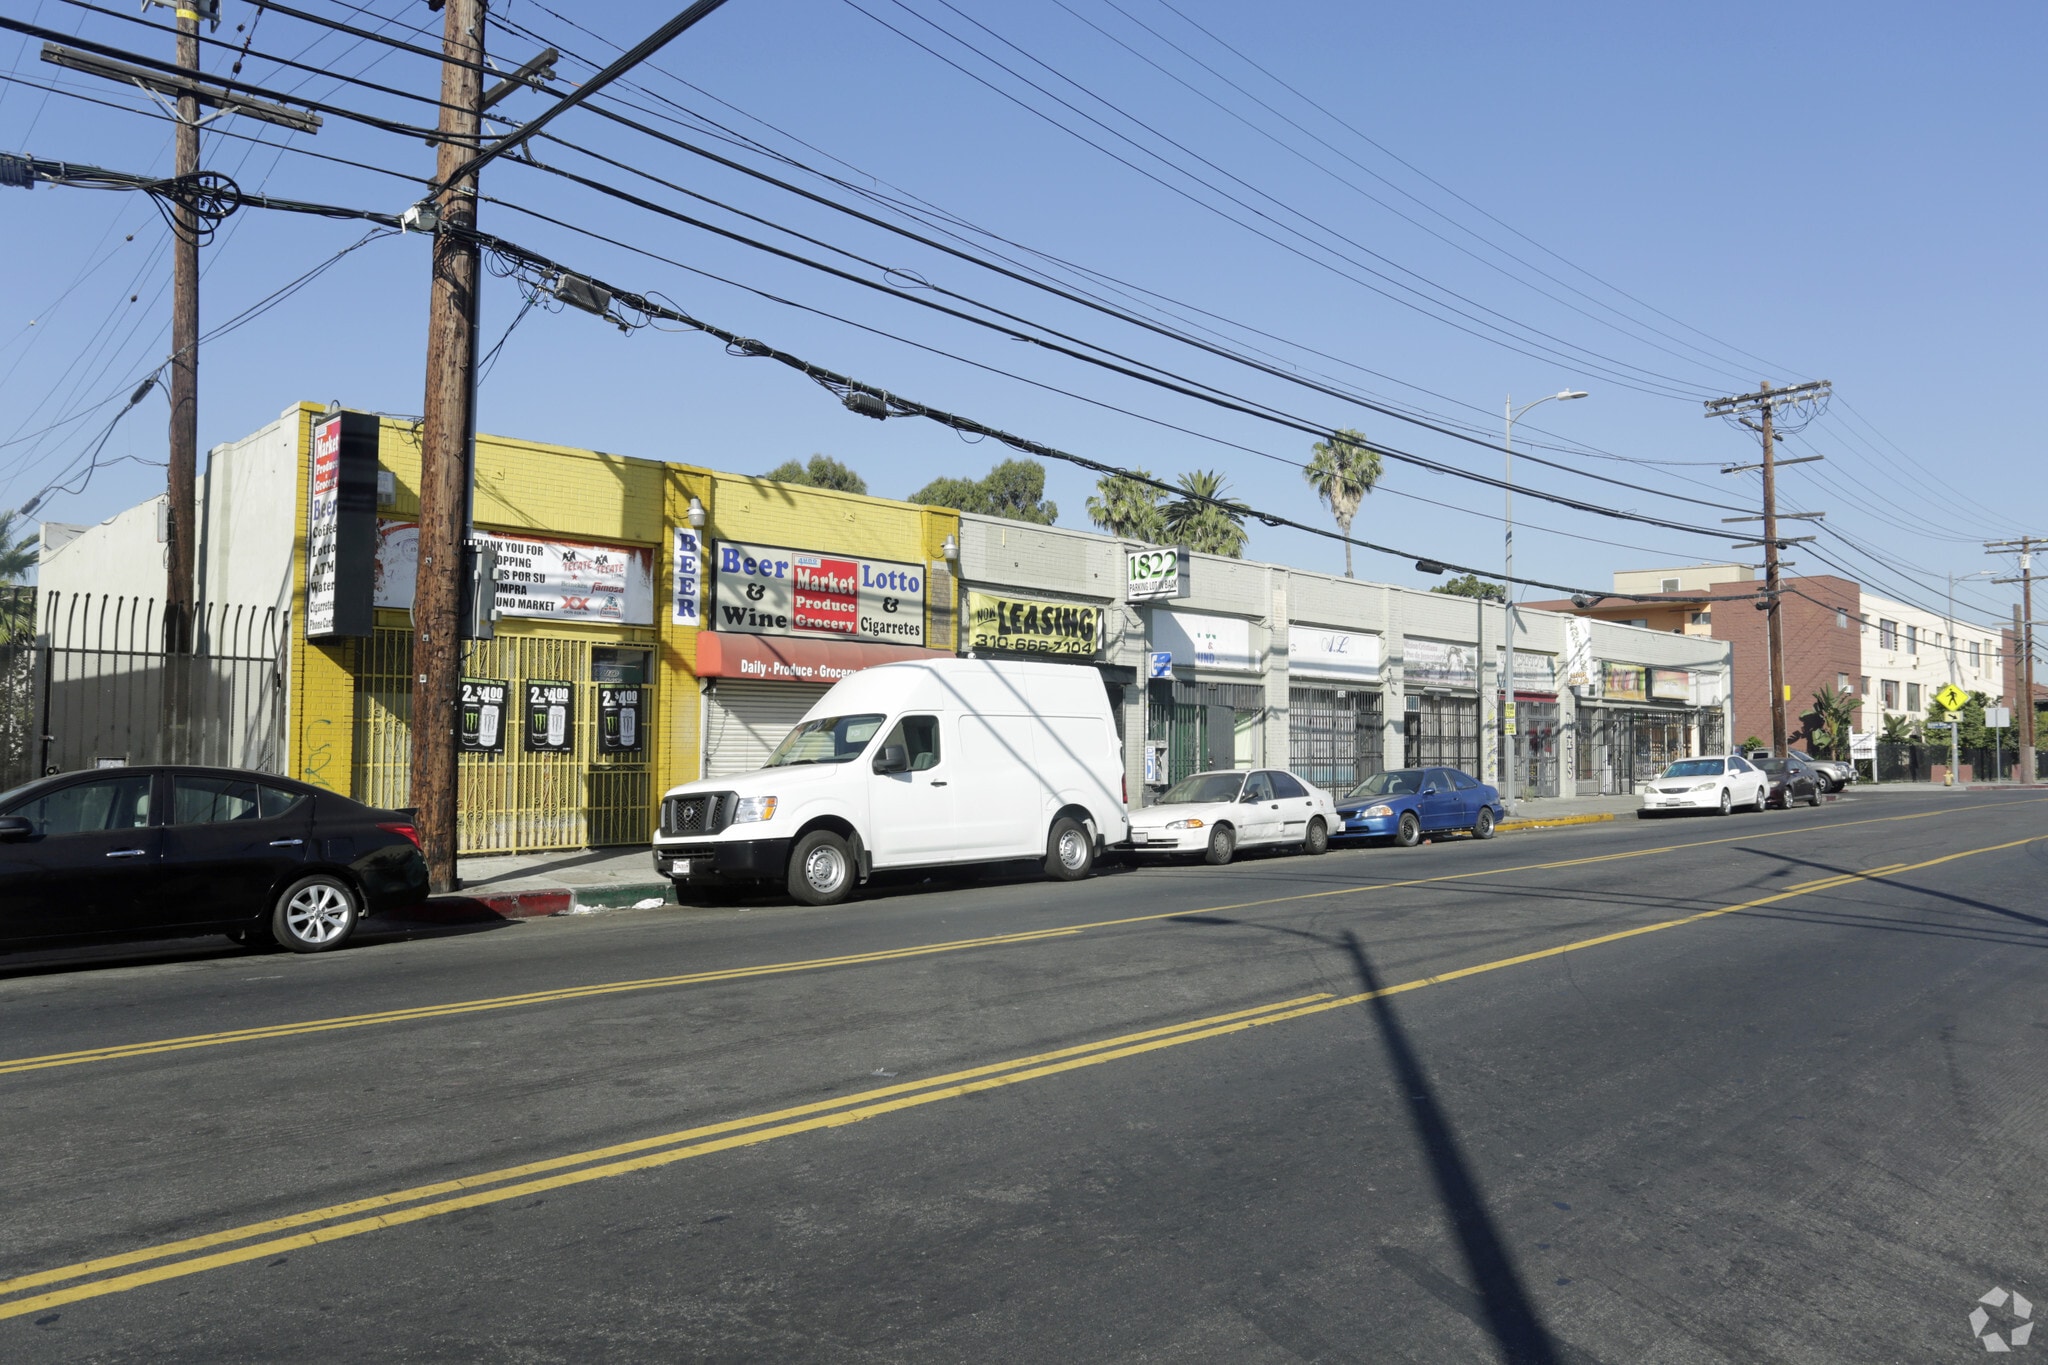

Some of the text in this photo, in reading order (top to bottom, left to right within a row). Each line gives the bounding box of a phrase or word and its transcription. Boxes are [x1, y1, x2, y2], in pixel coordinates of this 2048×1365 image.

[316, 433, 339, 458] Market
[315, 476, 338, 491] Grocery
[314, 499, 337, 520] Beer
[313, 523, 337, 539] Coffee
[312, 543, 336, 557] Lotto
[505, 543, 524, 554] YOU
[526, 545, 544, 556] FOR
[312, 561, 334, 576] ATM
[563, 560, 593, 571] TECATE
[595, 563, 624, 574] TECATE
[721, 547, 789, 578] Beer
[1130, 551, 1177, 581] 1822
[512, 570, 531, 582] POR
[533, 573, 546, 583] SU
[676, 533, 697, 618] BEER
[796, 567, 855, 595] Market
[862, 564, 920, 593] Lotto
[311, 581, 335, 594] Water
[746, 583, 766, 601] &
[1129, 582, 1149, 592] PARKING
[1149, 581, 1158, 590] LOT
[517, 600, 555, 611] MARKET
[795, 595, 855, 613] Produce
[882, 596, 900, 613] &
[722, 605, 787, 628] Wine
[795, 614, 855, 633] Grocery
[976, 600, 1094, 642] NOW LEASING
[860, 616, 920, 637] Cigarretes
[975, 634, 1092, 655] 310-666-7104
[741, 659, 767, 677] Daily
[773, 661, 813, 677] Produce
[462, 684, 473, 702] 2
[530, 686, 540, 703] 2
[602, 690, 612, 706] 2
